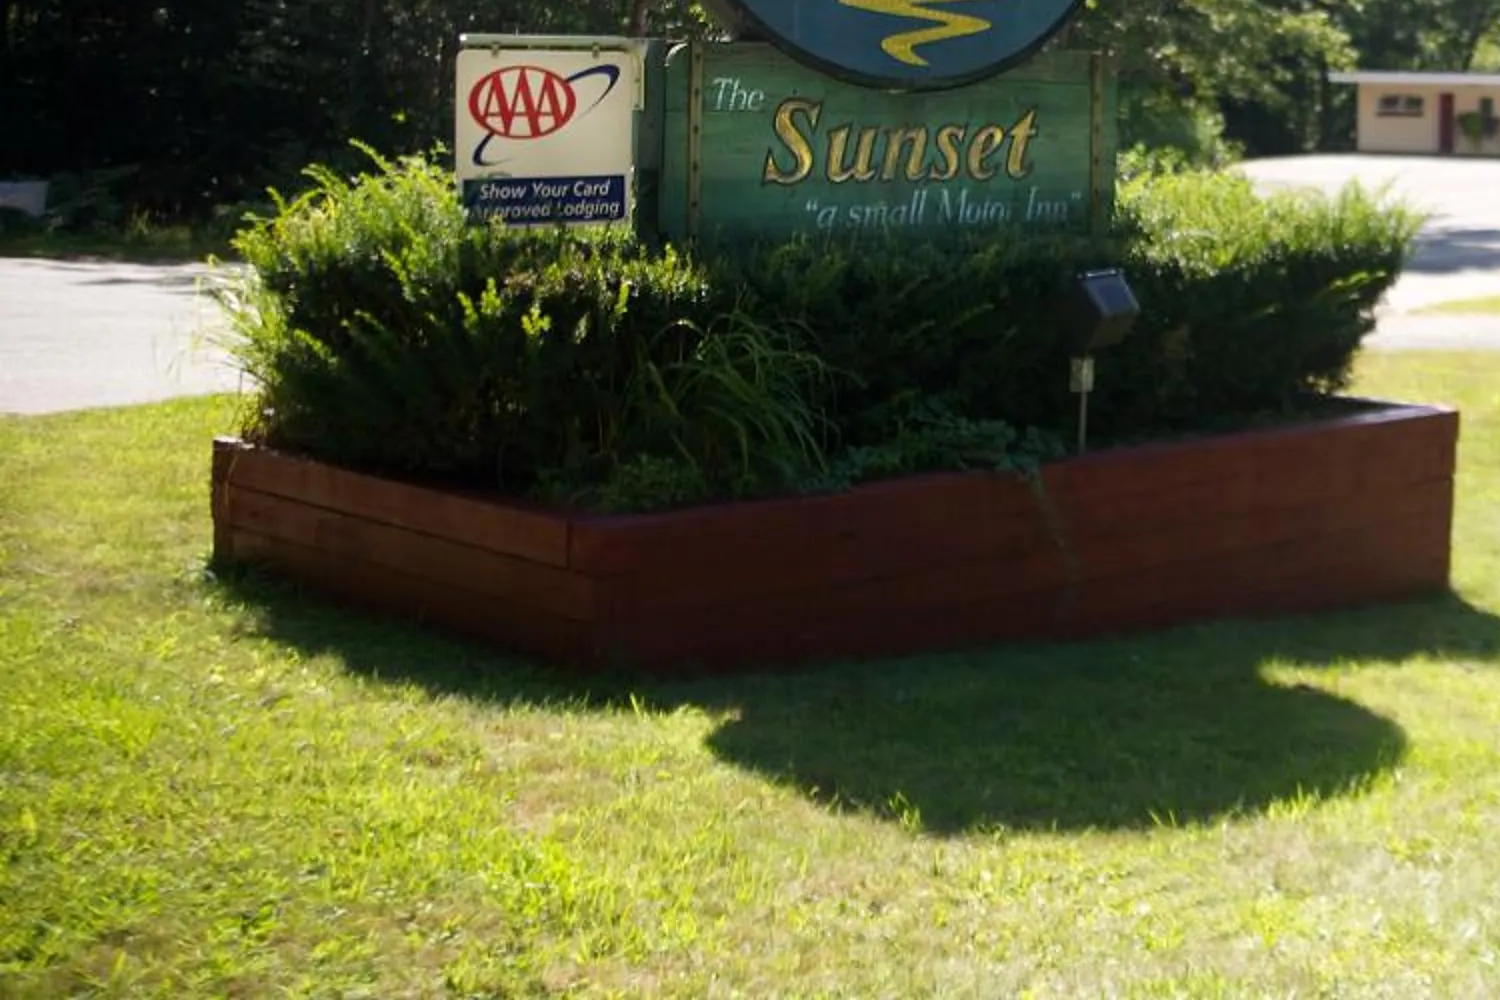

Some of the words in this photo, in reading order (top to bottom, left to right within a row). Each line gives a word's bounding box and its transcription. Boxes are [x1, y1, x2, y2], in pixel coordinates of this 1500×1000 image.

[476, 65, 570, 139] AAA
[712, 77, 764, 111] The
[761, 96, 1039, 185] Sunset
[479, 183, 527, 200] Show
[531, 181, 568, 198] Your
[572, 178, 611, 197] Card
[848, 188, 928, 226] small
